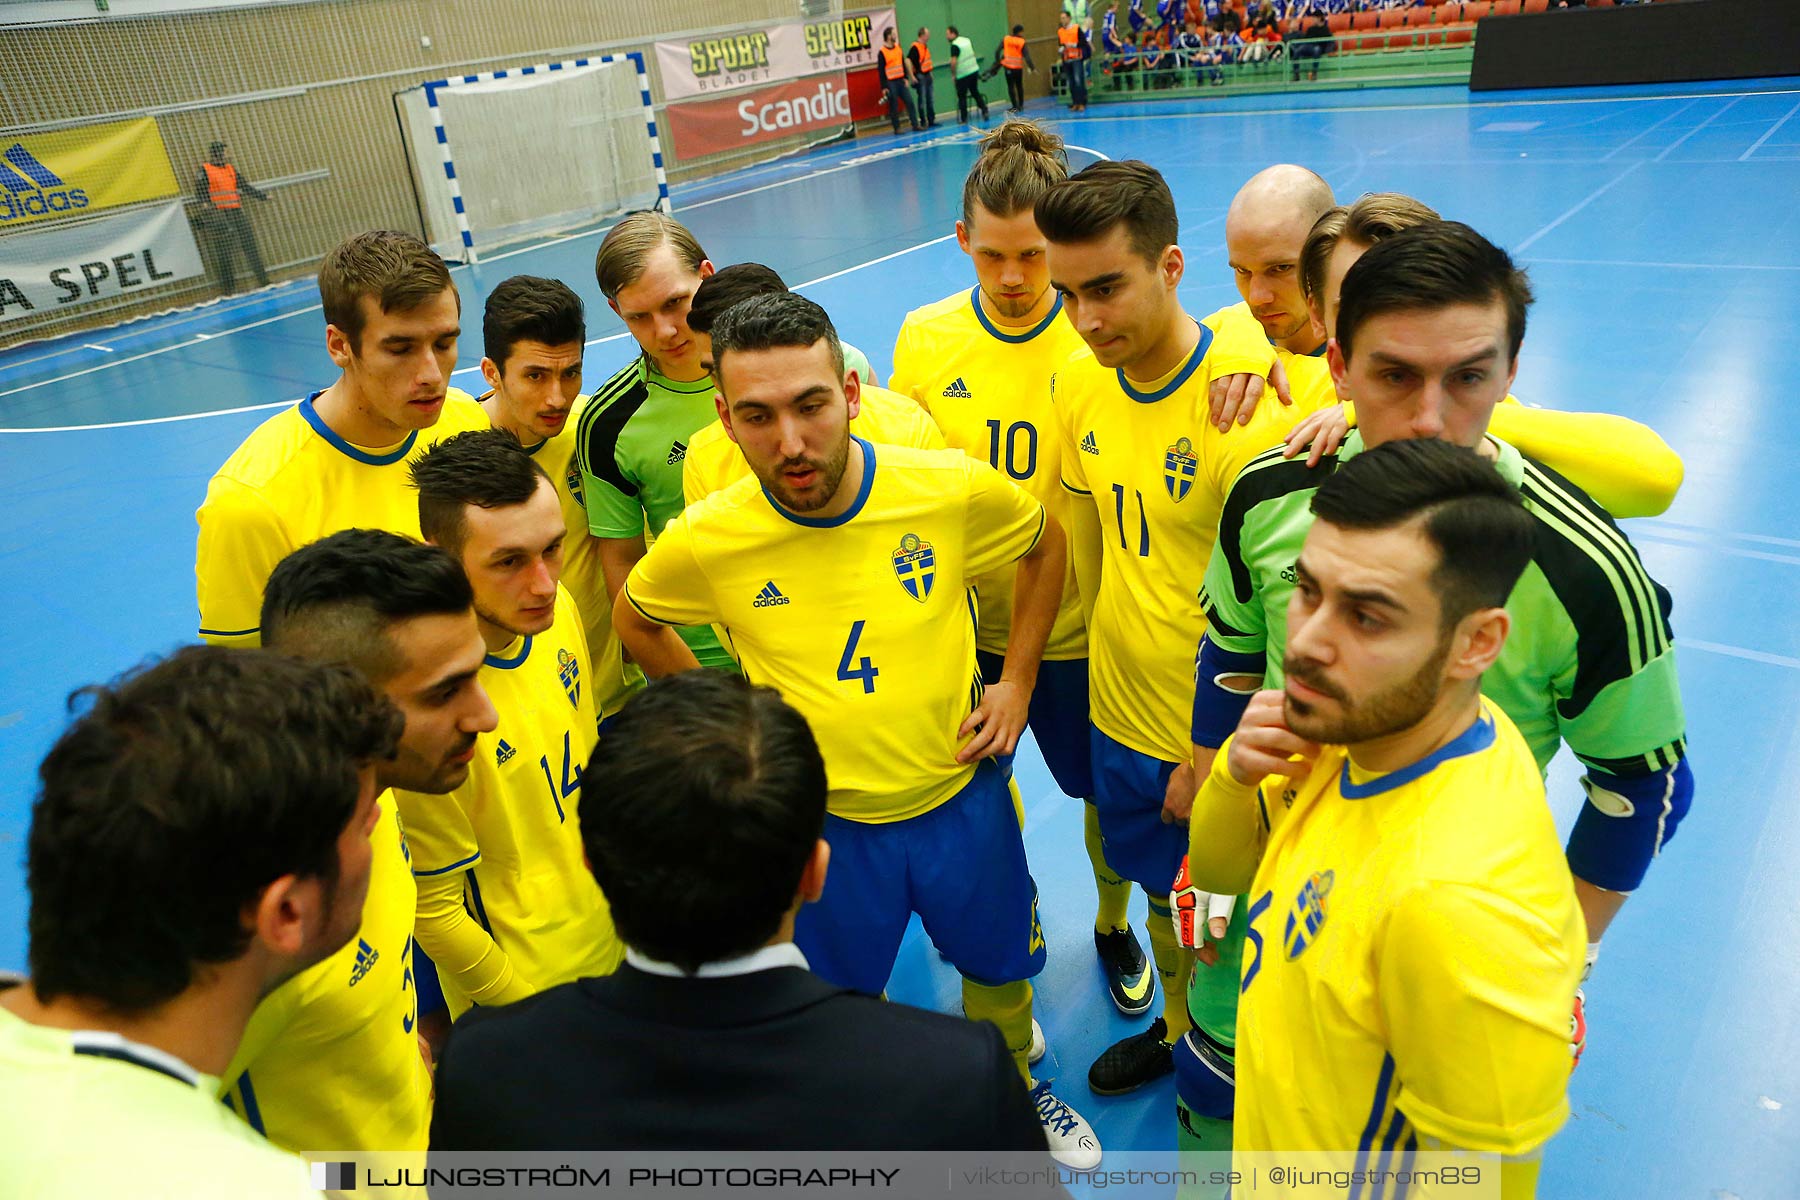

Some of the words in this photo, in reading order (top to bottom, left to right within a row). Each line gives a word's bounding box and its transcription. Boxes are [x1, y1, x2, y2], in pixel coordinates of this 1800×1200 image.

[688, 31, 771, 77] SPORT
[804, 15, 872, 59] SPORT
[699, 69, 771, 90] BLADET
[812, 51, 873, 70] BLADET
[738, 82, 851, 136] Scandic
[49, 248, 173, 304] SPEL
[943, 388, 971, 399] adidas
[987, 419, 1038, 480] 10
[1112, 483, 1150, 556] 11
[752, 594, 790, 608] adidas
[837, 620, 879, 694] 4
[540, 730, 584, 824] 14
[349, 949, 380, 987] adidas
